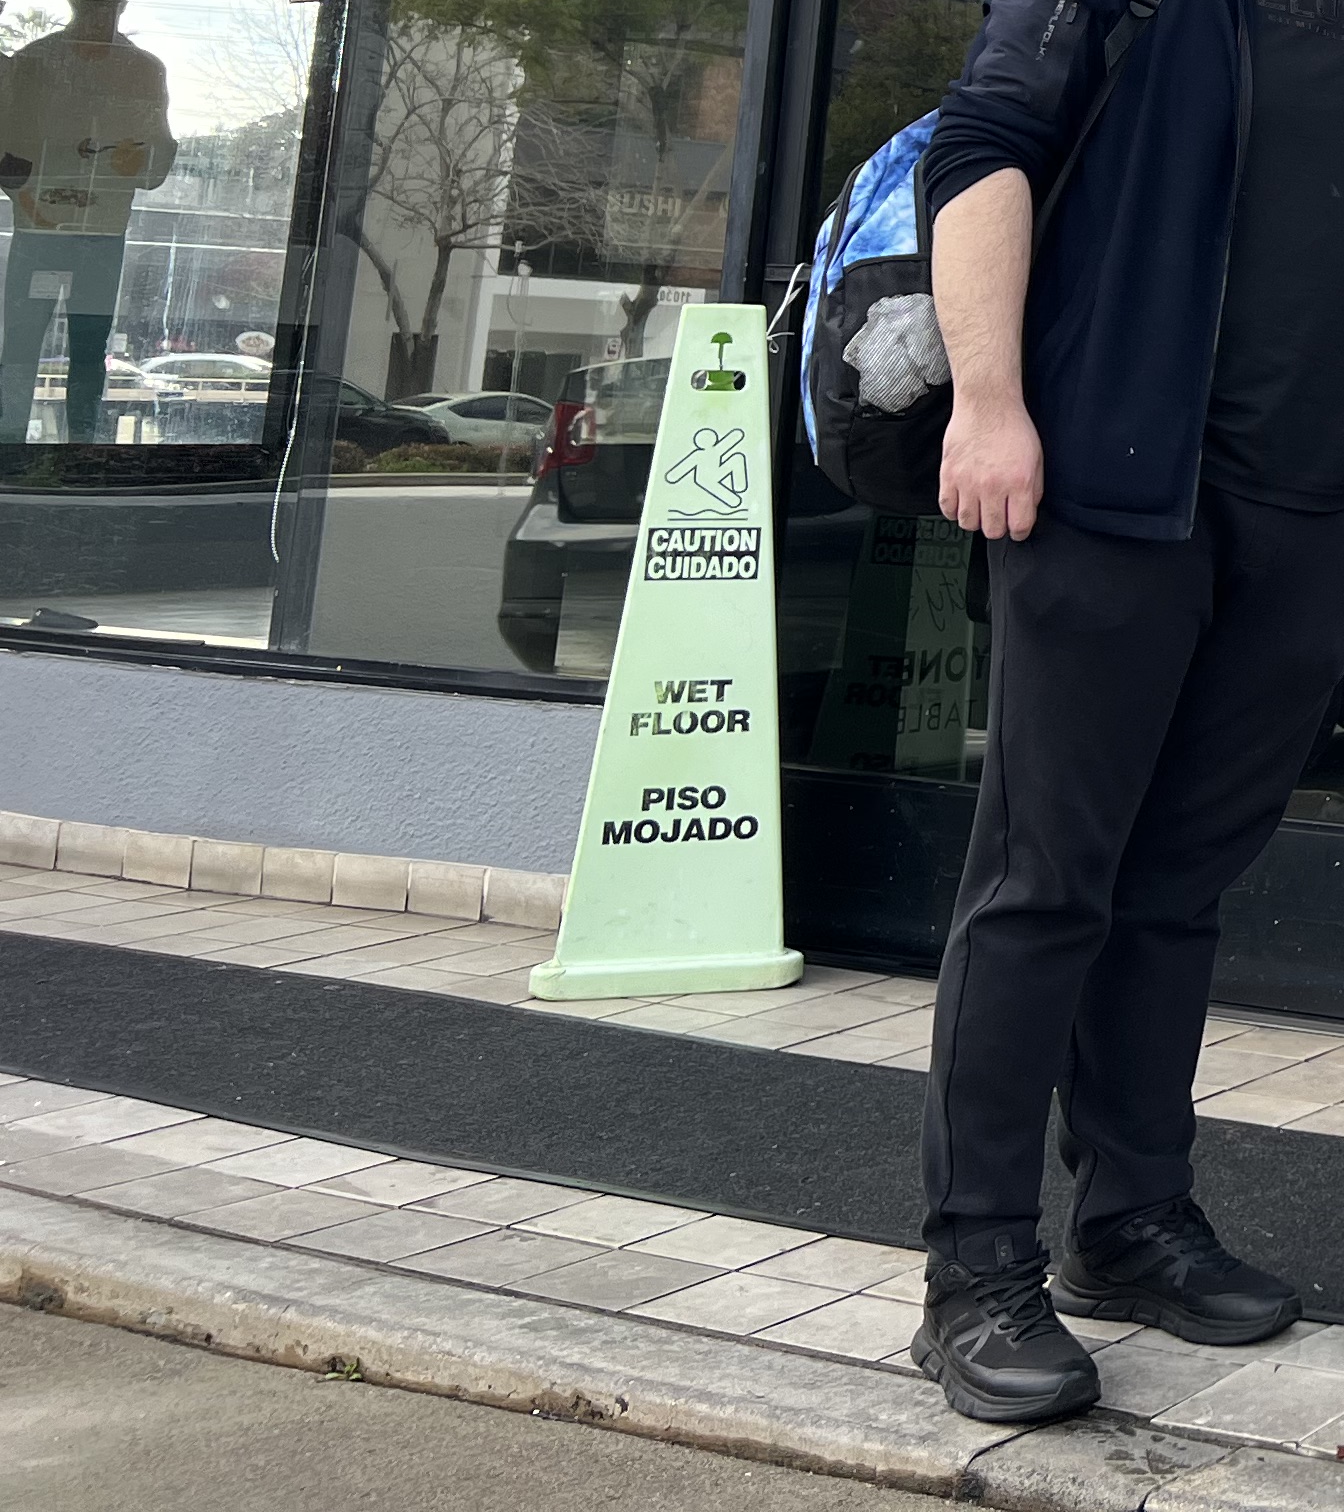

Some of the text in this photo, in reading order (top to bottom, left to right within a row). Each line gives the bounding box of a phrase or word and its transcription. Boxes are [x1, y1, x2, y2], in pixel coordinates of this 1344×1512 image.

[650, 529, 758, 553] CAUTION
[646, 555, 758, 580] CUIDADO
[655, 679, 732, 704] WET
[630, 710, 750, 737] FLOOR
[641, 785, 725, 811] PISO
[601, 815, 758, 845] MOJADO
